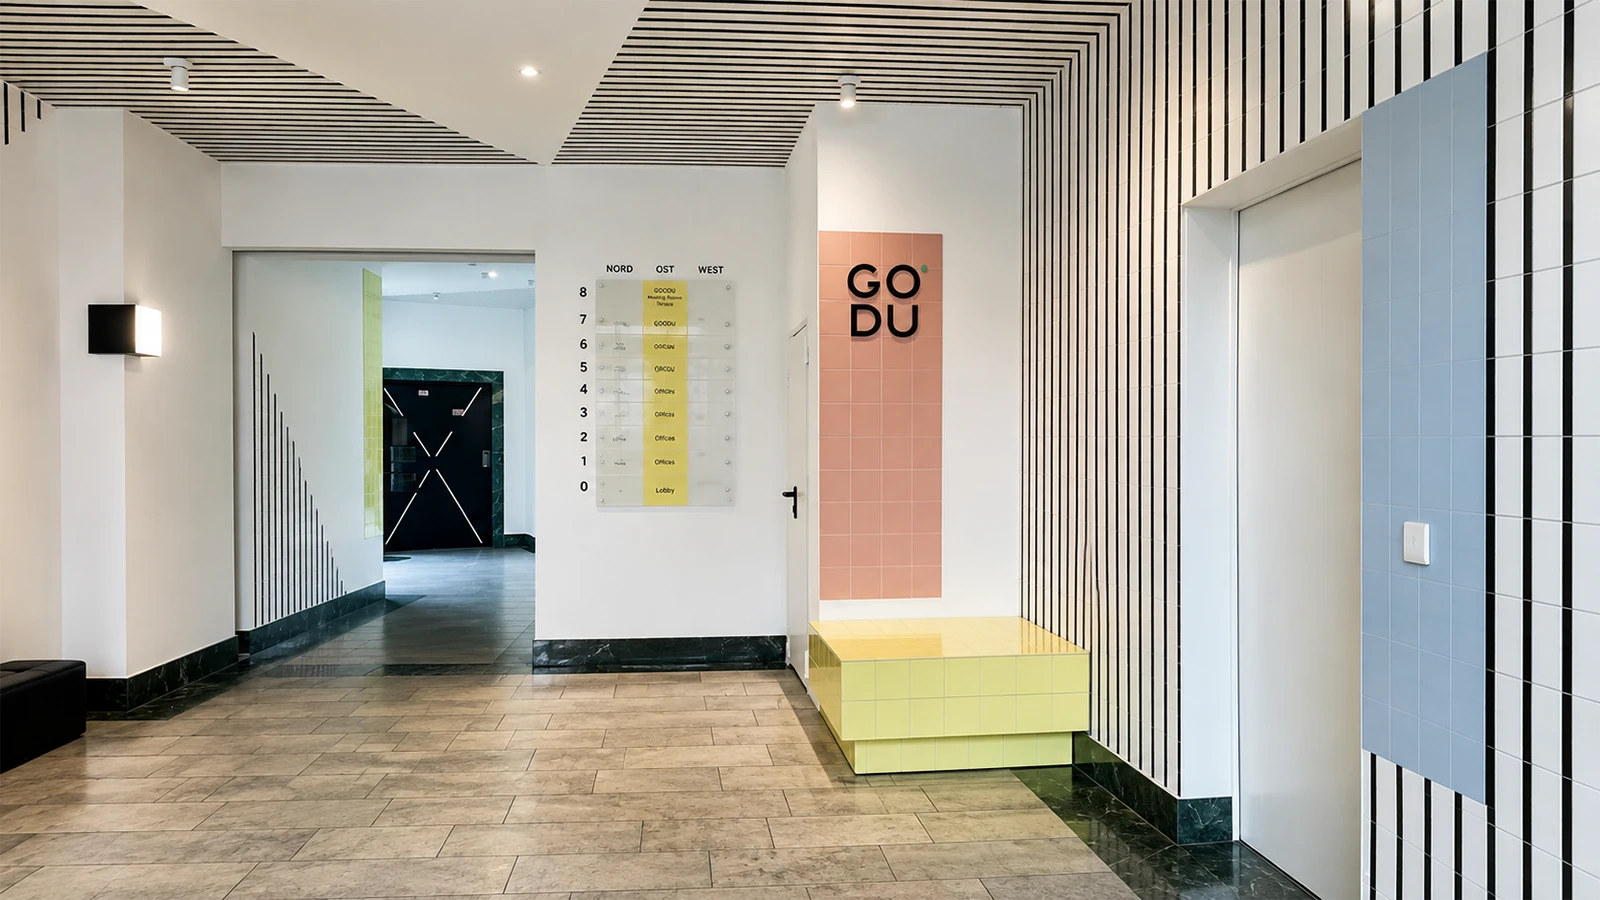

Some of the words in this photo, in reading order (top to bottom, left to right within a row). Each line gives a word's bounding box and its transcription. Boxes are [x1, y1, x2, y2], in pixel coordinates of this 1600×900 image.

[606, 264, 634, 274] NORD
[655, 265, 675, 274] OST
[697, 265, 724, 275] WEST
[847, 263, 921, 299] GO
[579, 286, 588, 298] 8
[579, 313, 587, 325] 7
[851, 304, 919, 338] DU
[579, 338, 588, 350] 6
[580, 361, 588, 373] 5
[579, 383, 588, 395] 4
[580, 406, 588, 418] 3
[580, 431, 588, 442] 2
[581, 455, 587, 467] 1
[579, 480, 589, 492] 0
[655, 486, 675, 495] Lobby
